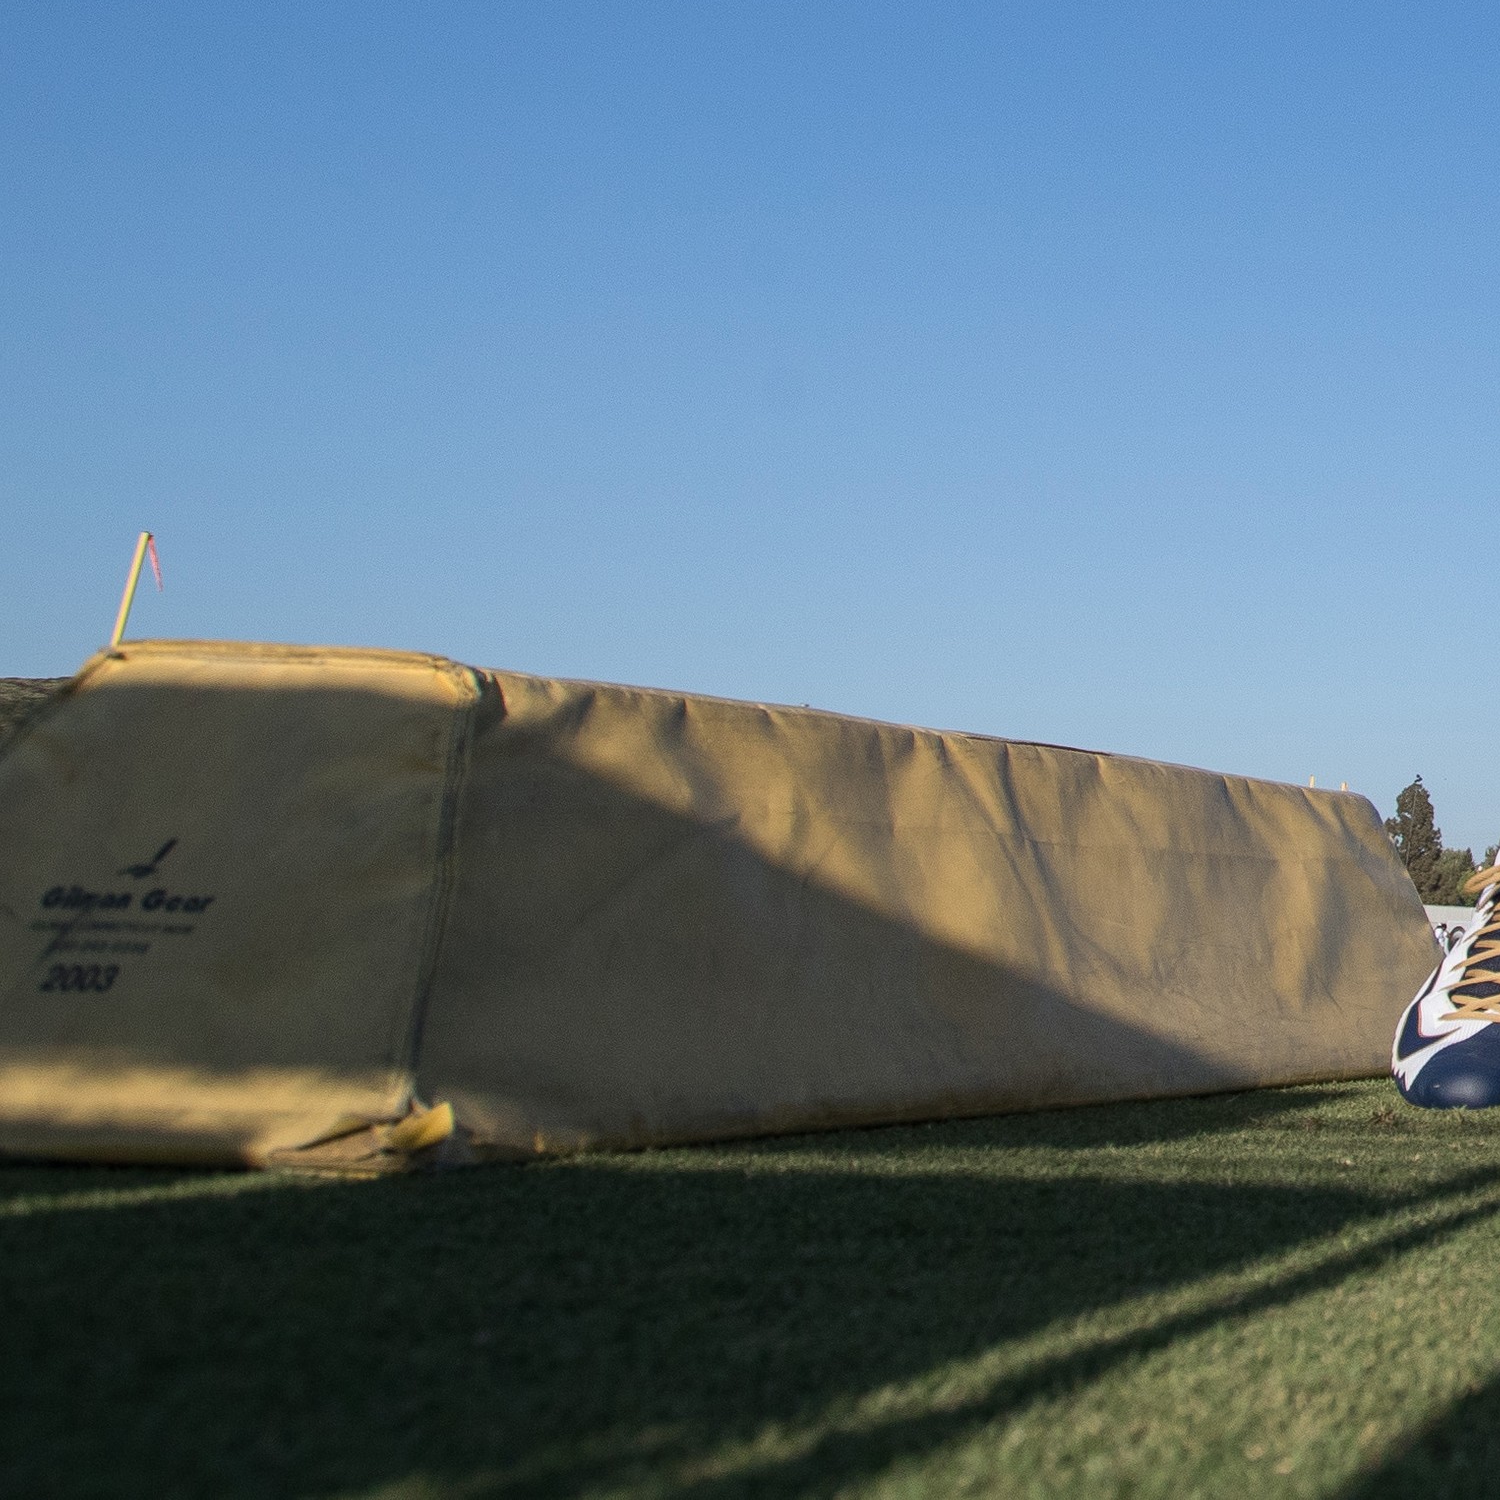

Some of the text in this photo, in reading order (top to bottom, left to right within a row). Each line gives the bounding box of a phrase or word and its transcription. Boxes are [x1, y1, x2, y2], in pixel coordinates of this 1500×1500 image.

[40, 885, 215, 913] Gilman Gear
[39, 963, 121, 992] 2003
